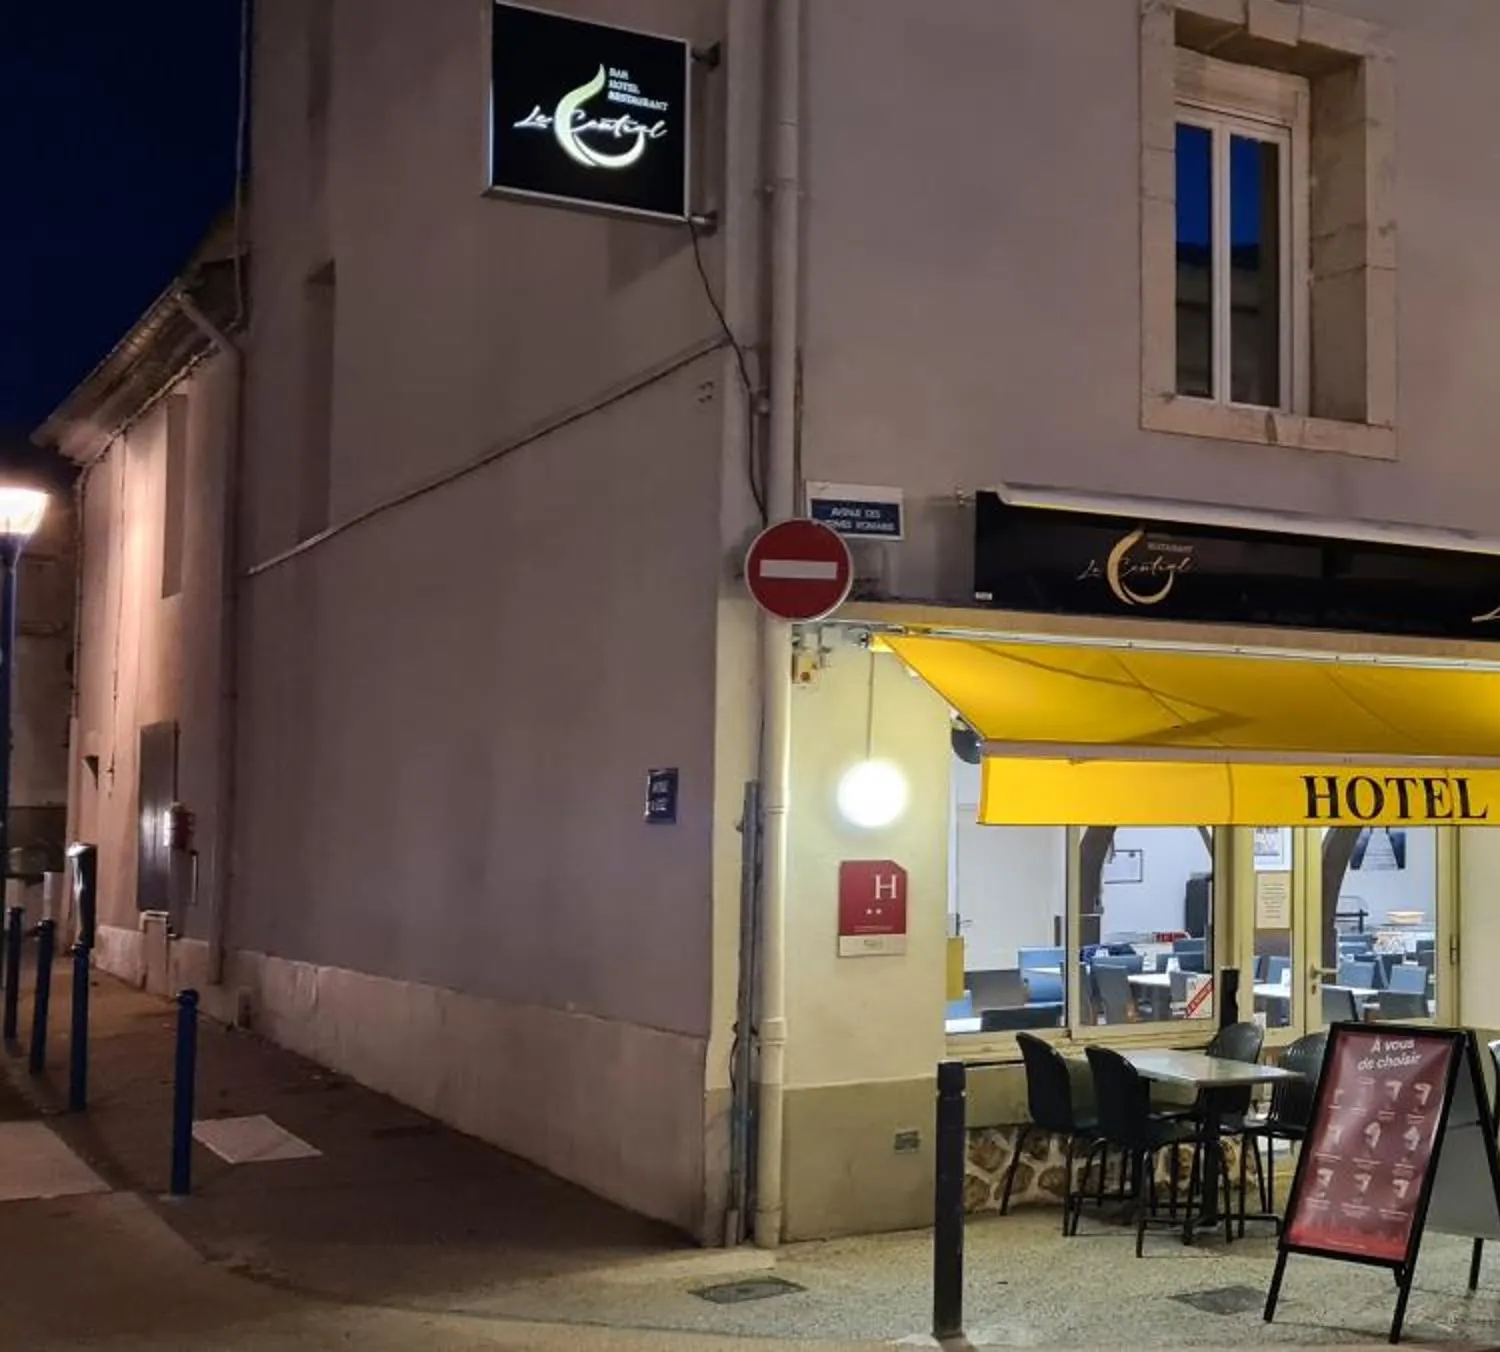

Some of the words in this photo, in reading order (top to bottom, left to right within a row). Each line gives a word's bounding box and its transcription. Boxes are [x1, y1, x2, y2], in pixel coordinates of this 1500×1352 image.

[608, 67, 630, 81] BAR
[512, 105, 554, 129] Le
[1301, 775, 1489, 821] HOTEL
[875, 874, 897, 899] H
[1385, 1039, 1415, 1051] vous
[1357, 1056, 1374, 1071] de
[1376, 1051, 1422, 1069] choisir
